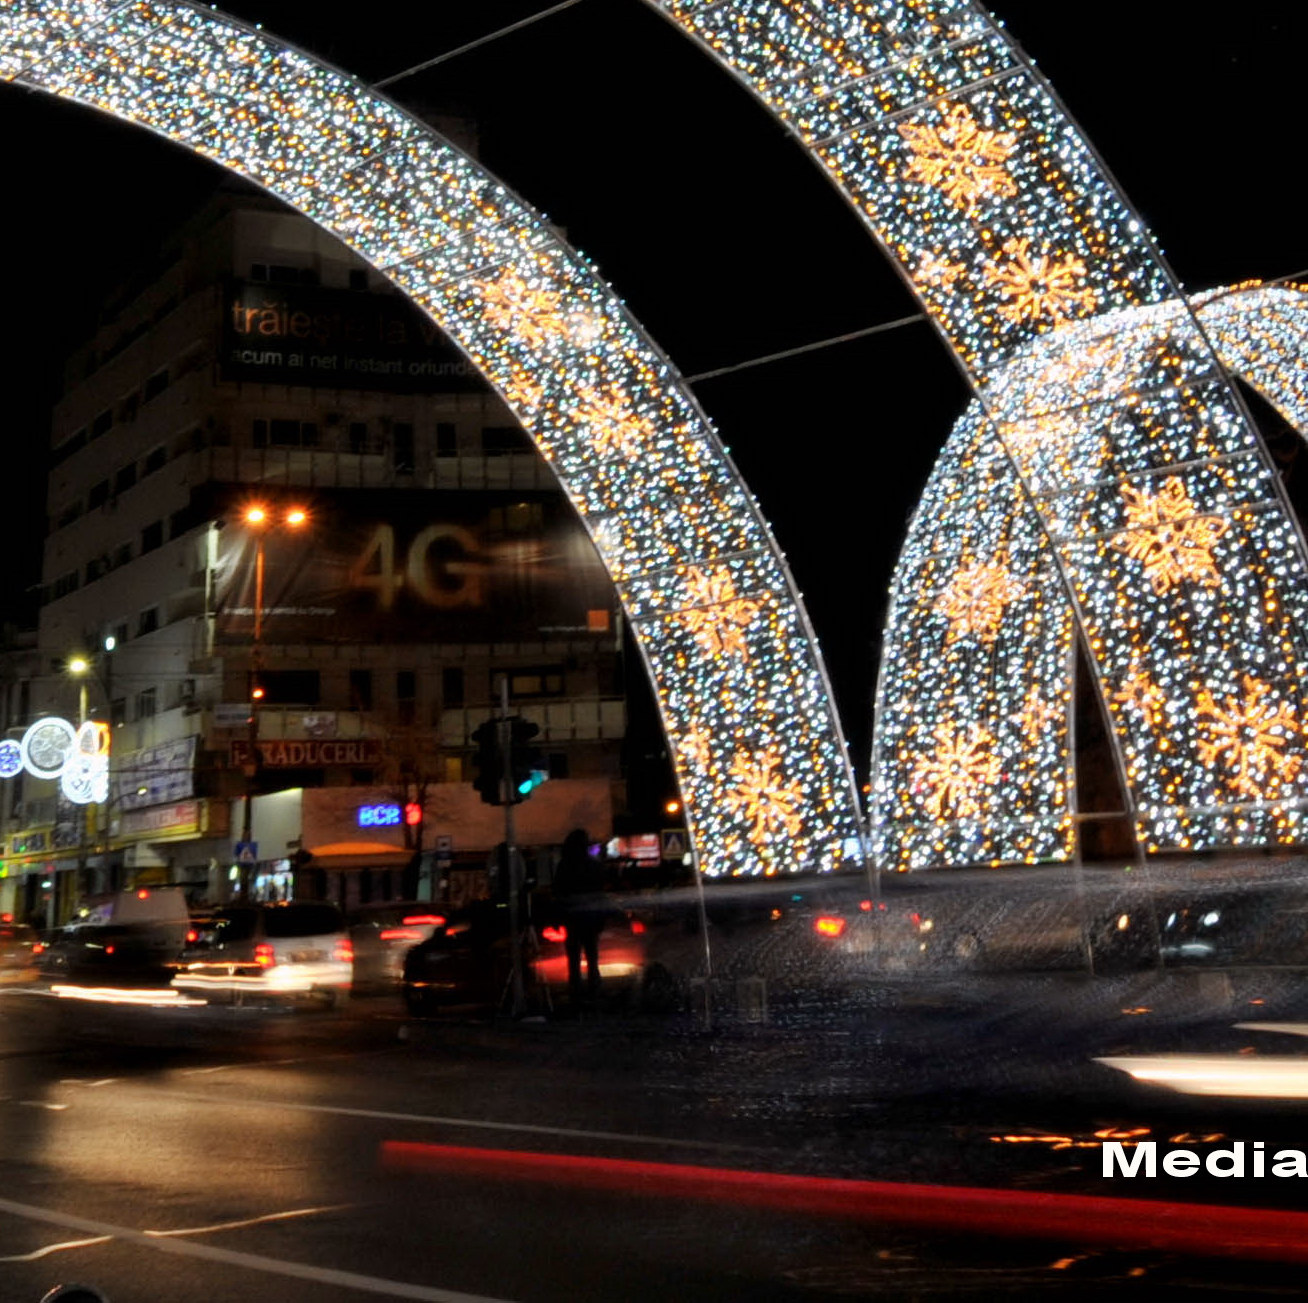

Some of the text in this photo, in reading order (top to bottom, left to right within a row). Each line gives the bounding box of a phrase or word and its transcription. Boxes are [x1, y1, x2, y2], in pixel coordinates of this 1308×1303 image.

[231, 349, 283, 366] acum
[288, 351, 304, 369] ai
[309, 353, 339, 371] net
[344, 353, 403, 375] instant
[348, 523, 485, 611] 4G
